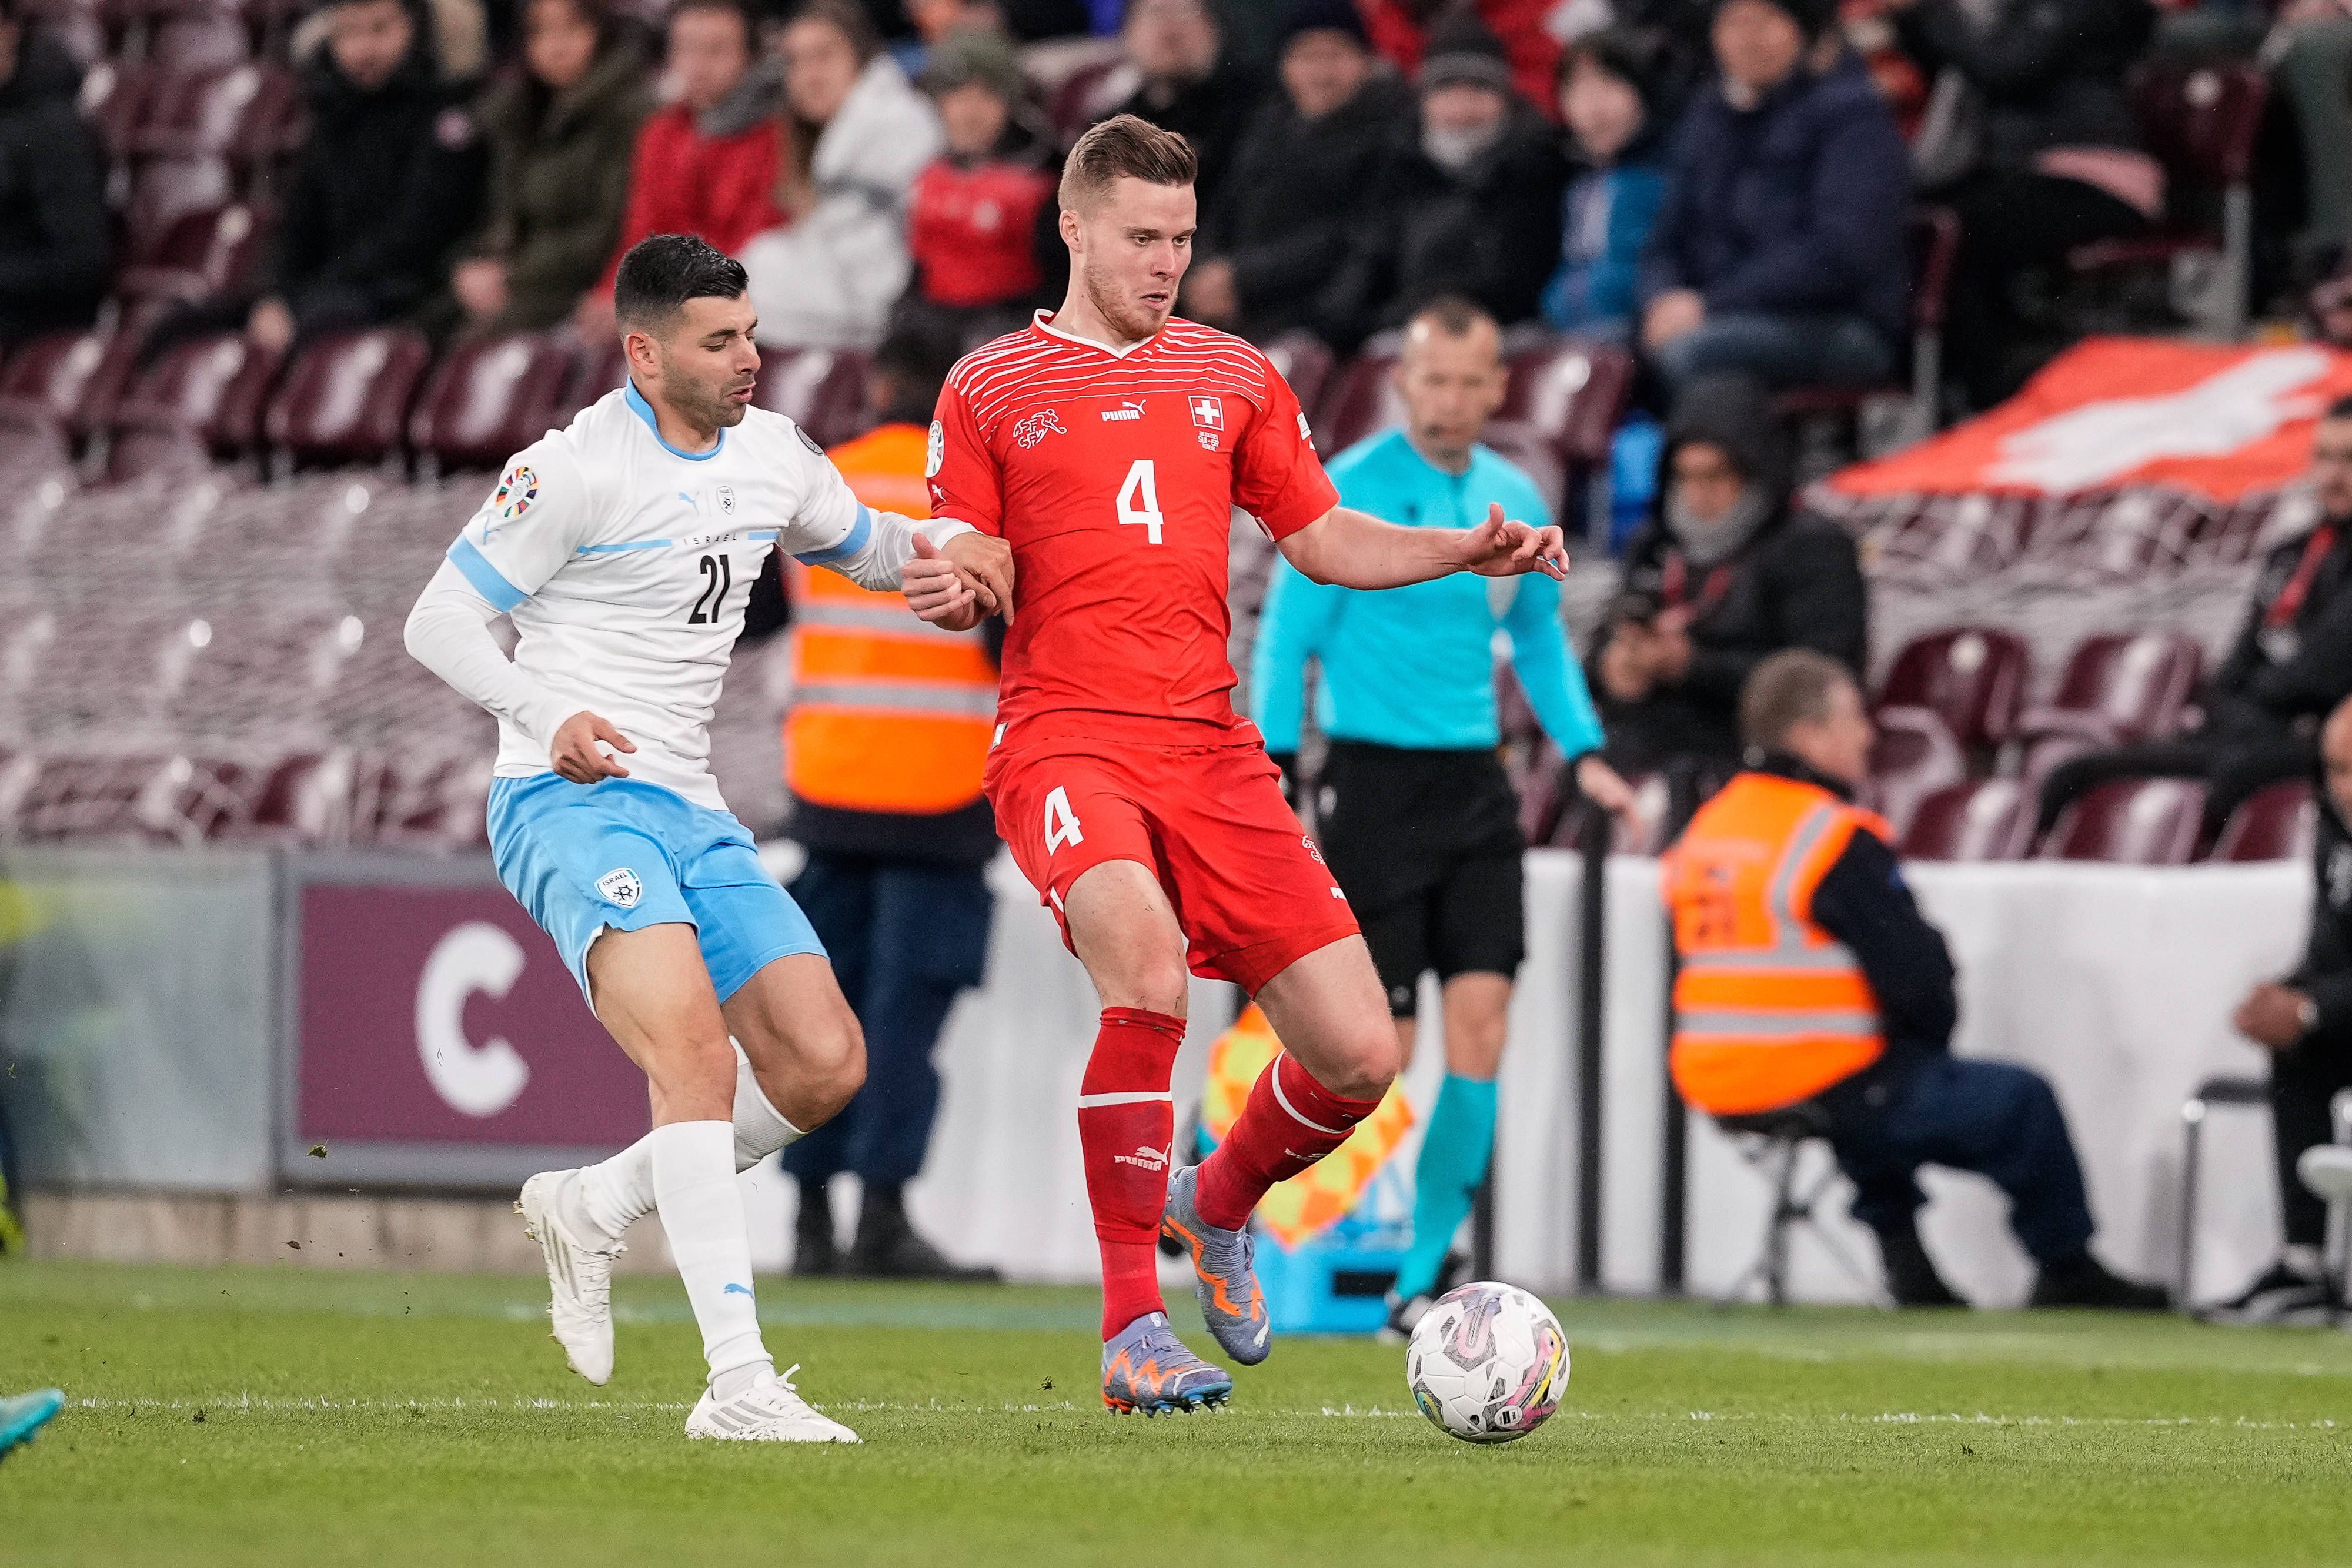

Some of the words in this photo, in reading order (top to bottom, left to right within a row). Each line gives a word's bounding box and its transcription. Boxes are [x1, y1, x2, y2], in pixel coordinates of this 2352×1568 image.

[1101, 410, 1140, 422] PUMA
[1115, 459, 1164, 544] 4
[683, 533, 737, 546] ISRAEL
[687, 554, 731, 624] 21
[1044, 785, 1085, 857] 4
[602, 872, 628, 887] ISRAEL
[415, 920, 530, 1118] C
[1114, 1155, 1162, 1171] PUMA
